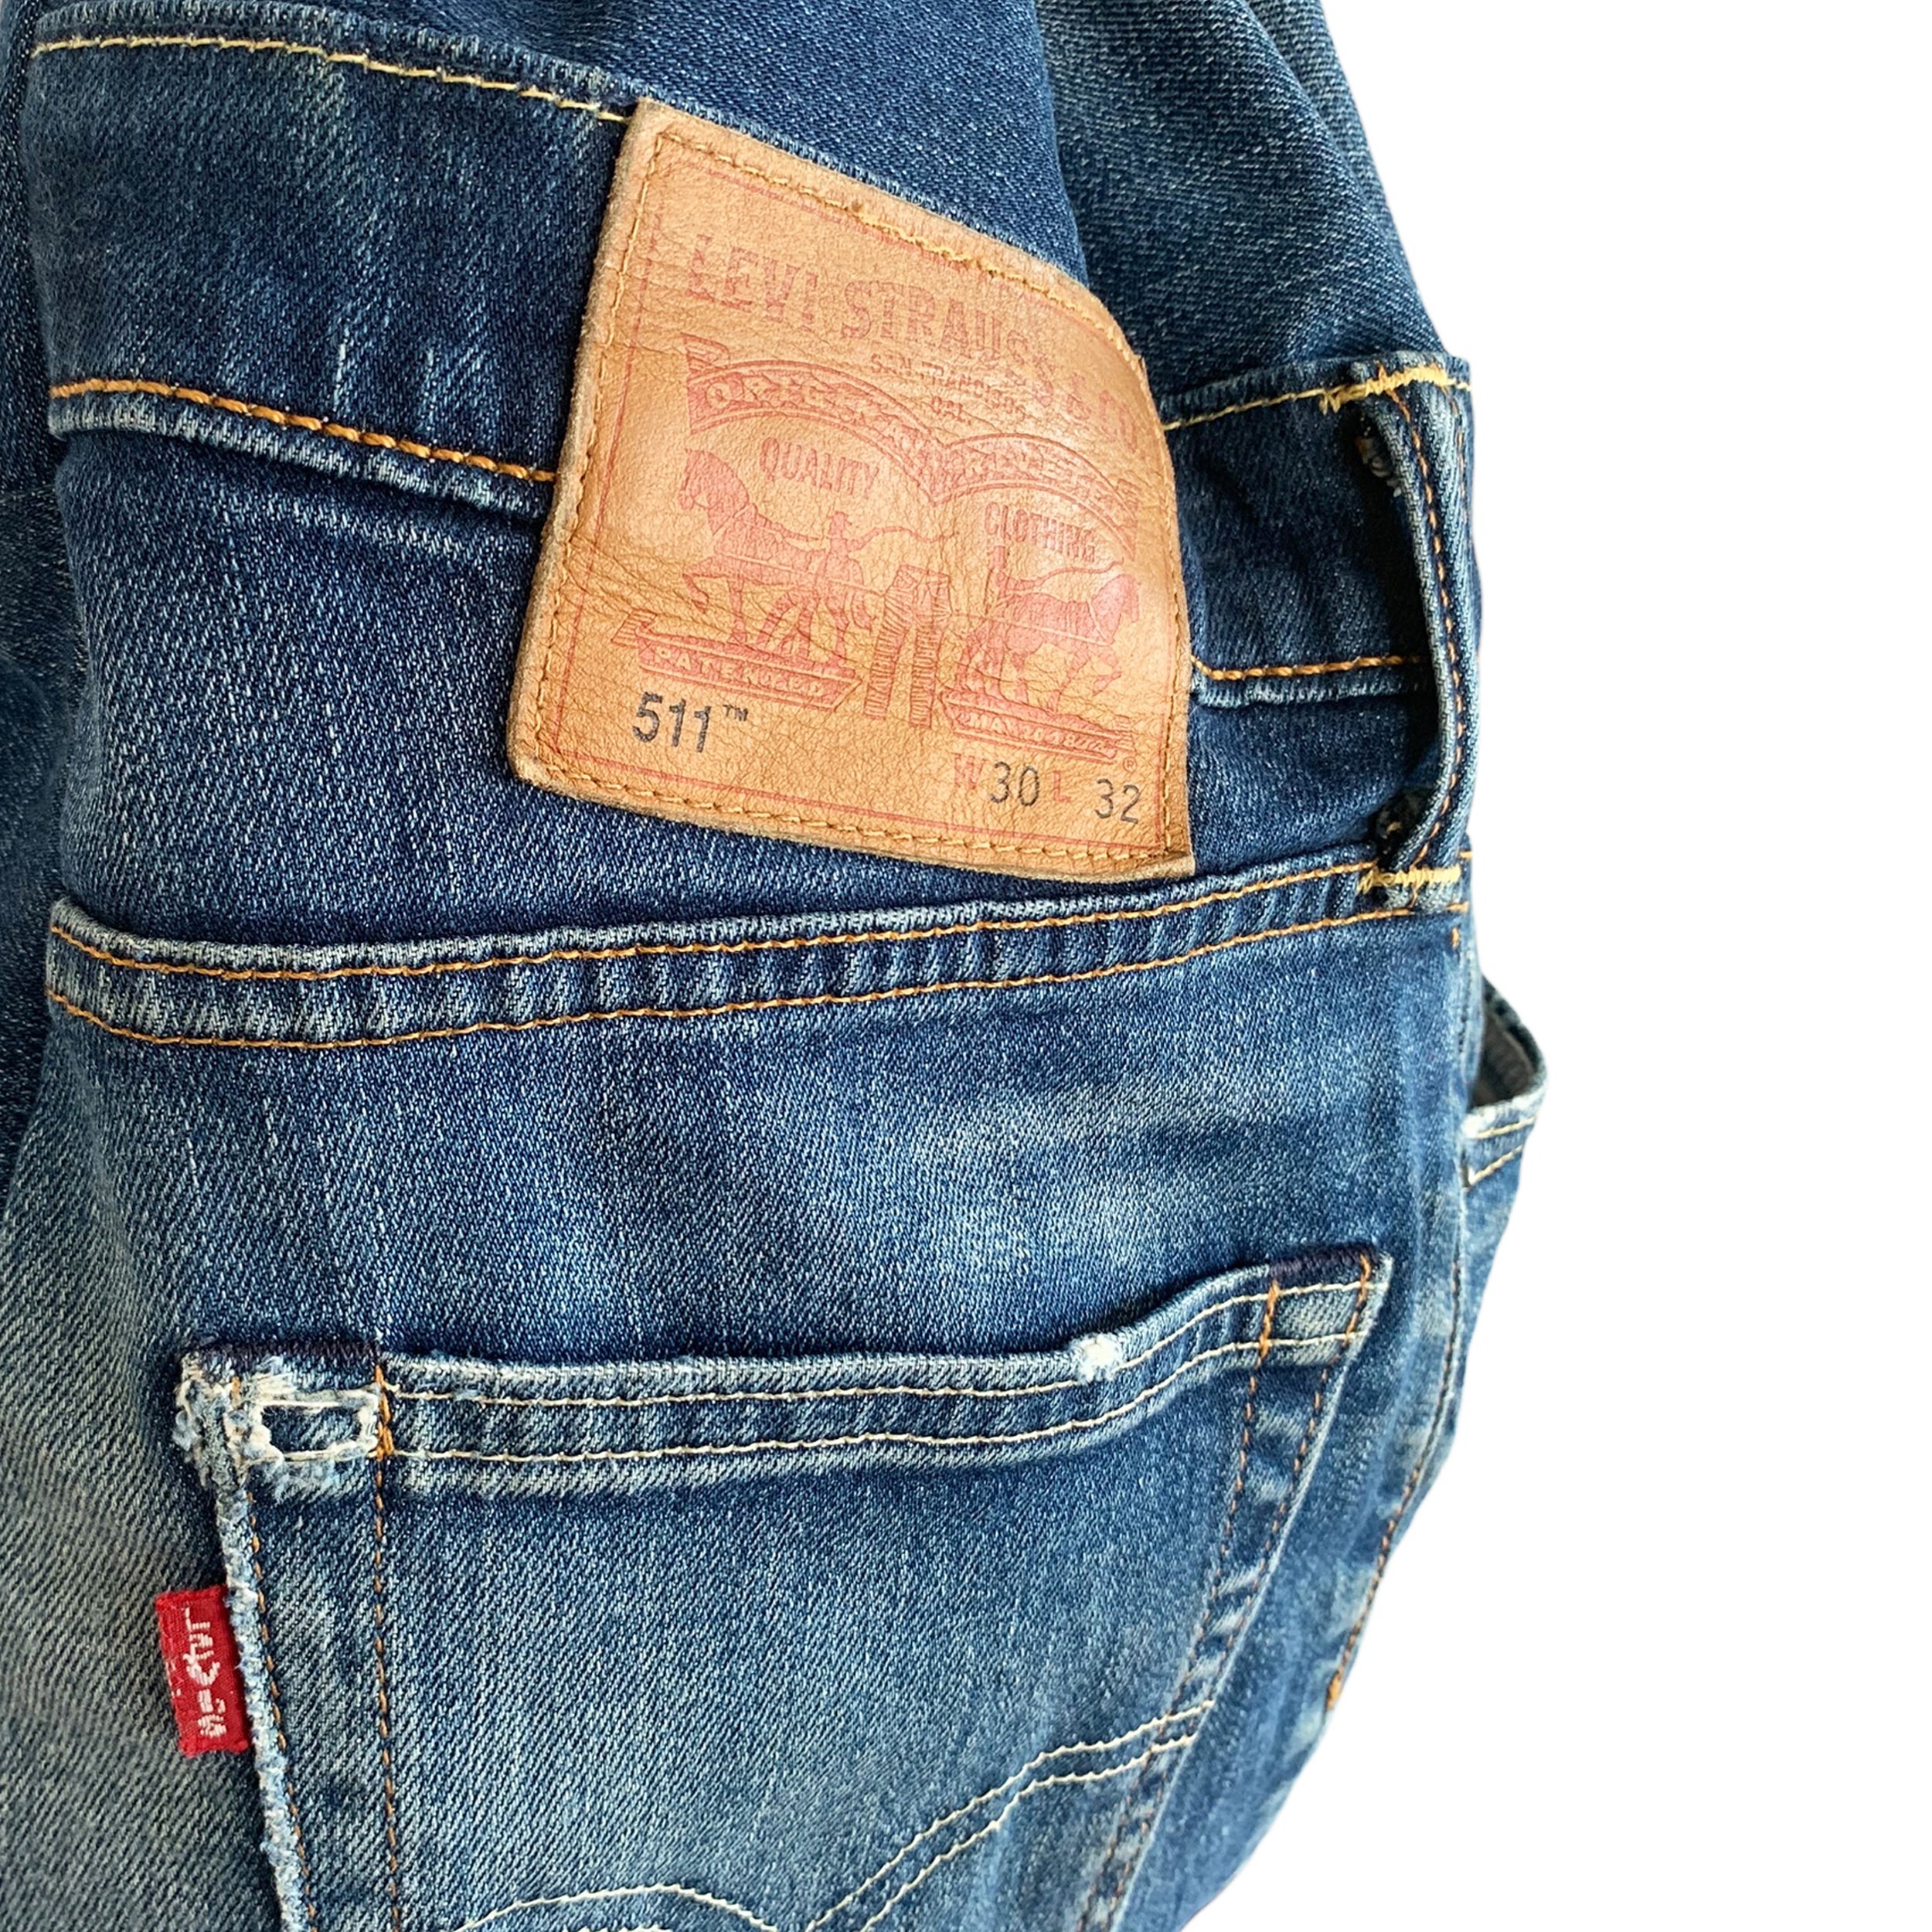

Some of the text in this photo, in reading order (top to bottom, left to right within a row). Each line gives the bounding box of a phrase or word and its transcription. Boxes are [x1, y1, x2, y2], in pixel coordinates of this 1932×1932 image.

[685, 233, 819, 332] LEVI
[759, 437, 879, 496] QUALITY
[984, 502, 1096, 563] CLOTHING
[990, 761, 1040, 807] 30
[1052, 770, 1072, 803] L
[1094, 777, 1141, 825] 32
